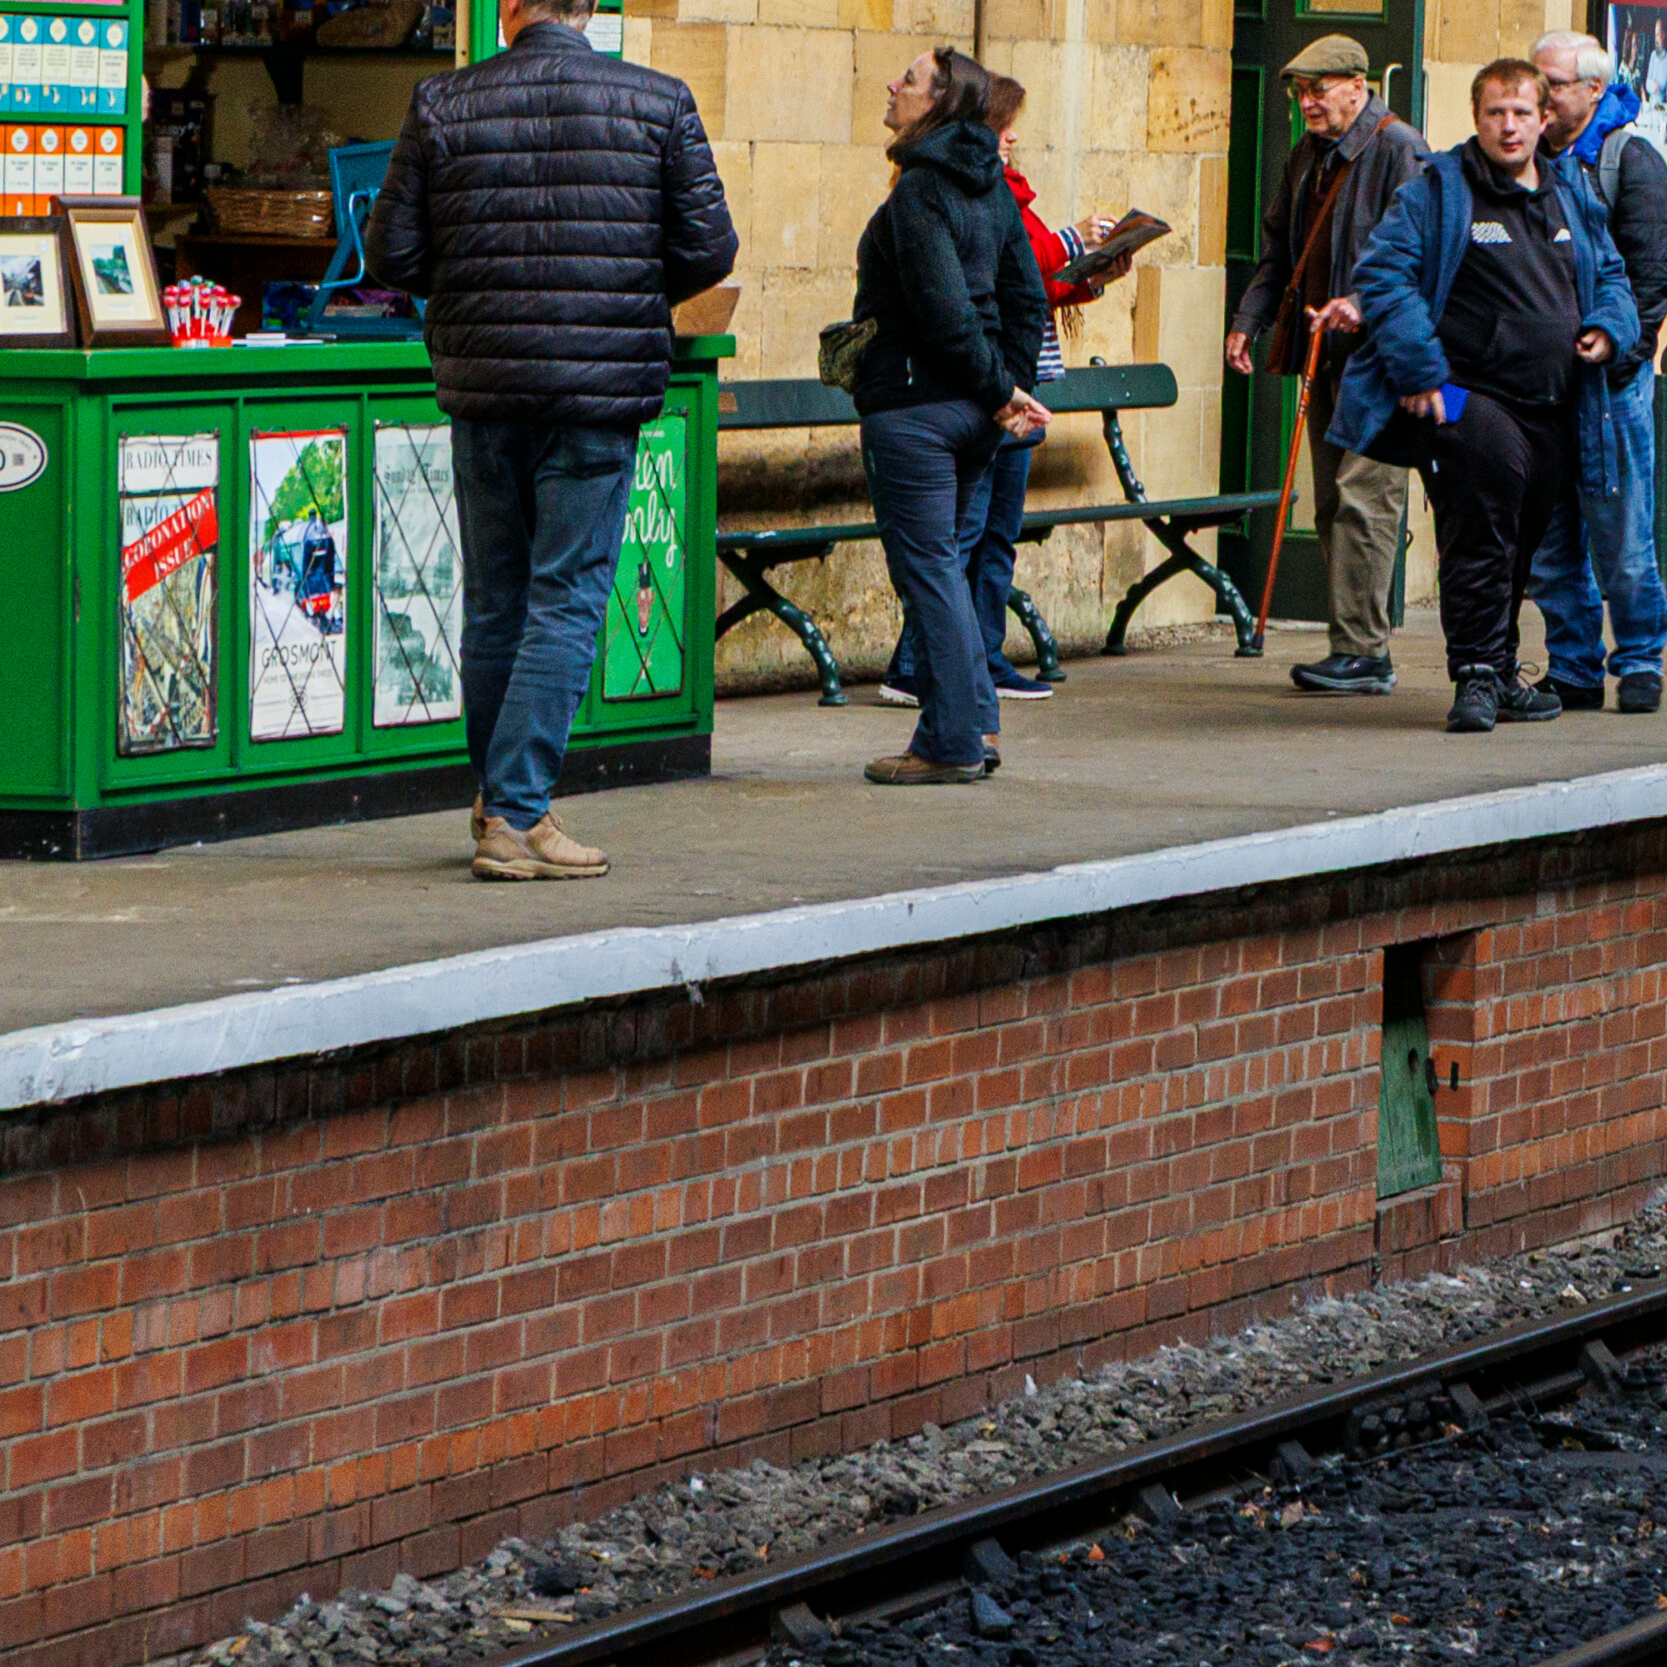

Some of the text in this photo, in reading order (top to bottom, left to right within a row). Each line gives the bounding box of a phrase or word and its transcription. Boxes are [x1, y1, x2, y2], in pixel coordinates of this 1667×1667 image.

[126, 447, 213, 471] RADIO TIMES
[421, 462, 450, 483] Times
[126, 504, 169, 527] RADIO
[123, 494, 213, 570] CORONATION
[154, 537, 195, 581] ISSUE
[261, 640, 337, 669] GROSMONT
